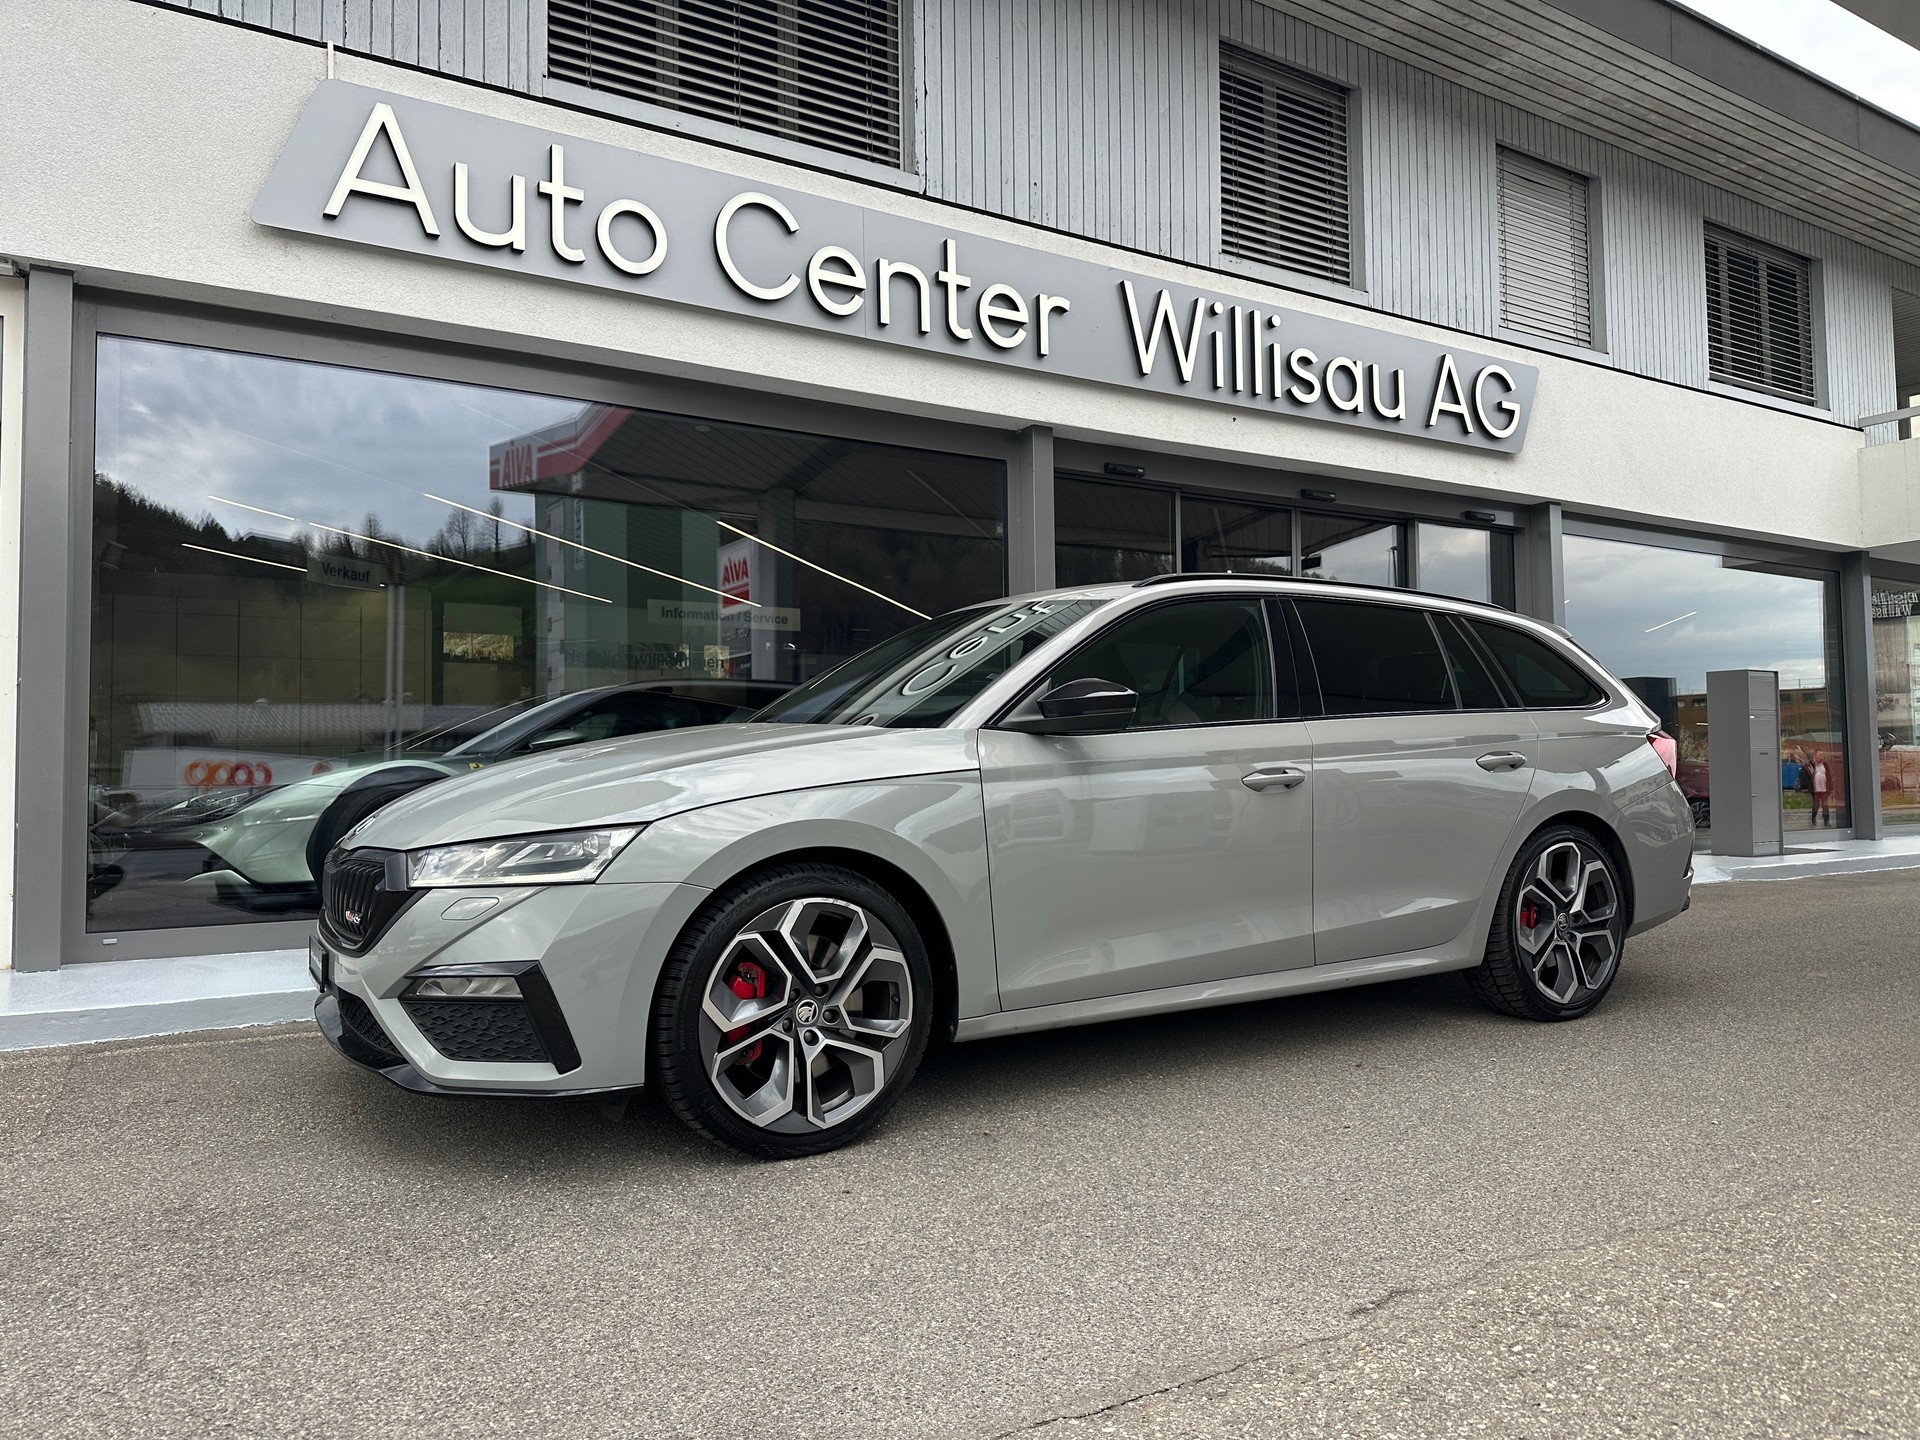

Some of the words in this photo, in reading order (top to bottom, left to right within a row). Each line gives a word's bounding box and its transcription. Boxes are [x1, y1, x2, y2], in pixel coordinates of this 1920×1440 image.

[323, 102, 668, 276] Auto
[714, 190, 1070, 358] Center
[1122, 279, 1406, 421] Willisau
[1426, 353, 1522, 439] AG
[321, 562, 370, 583] Verkauf
[661, 606, 735, 621] Information
[743, 610, 788, 625] Service
